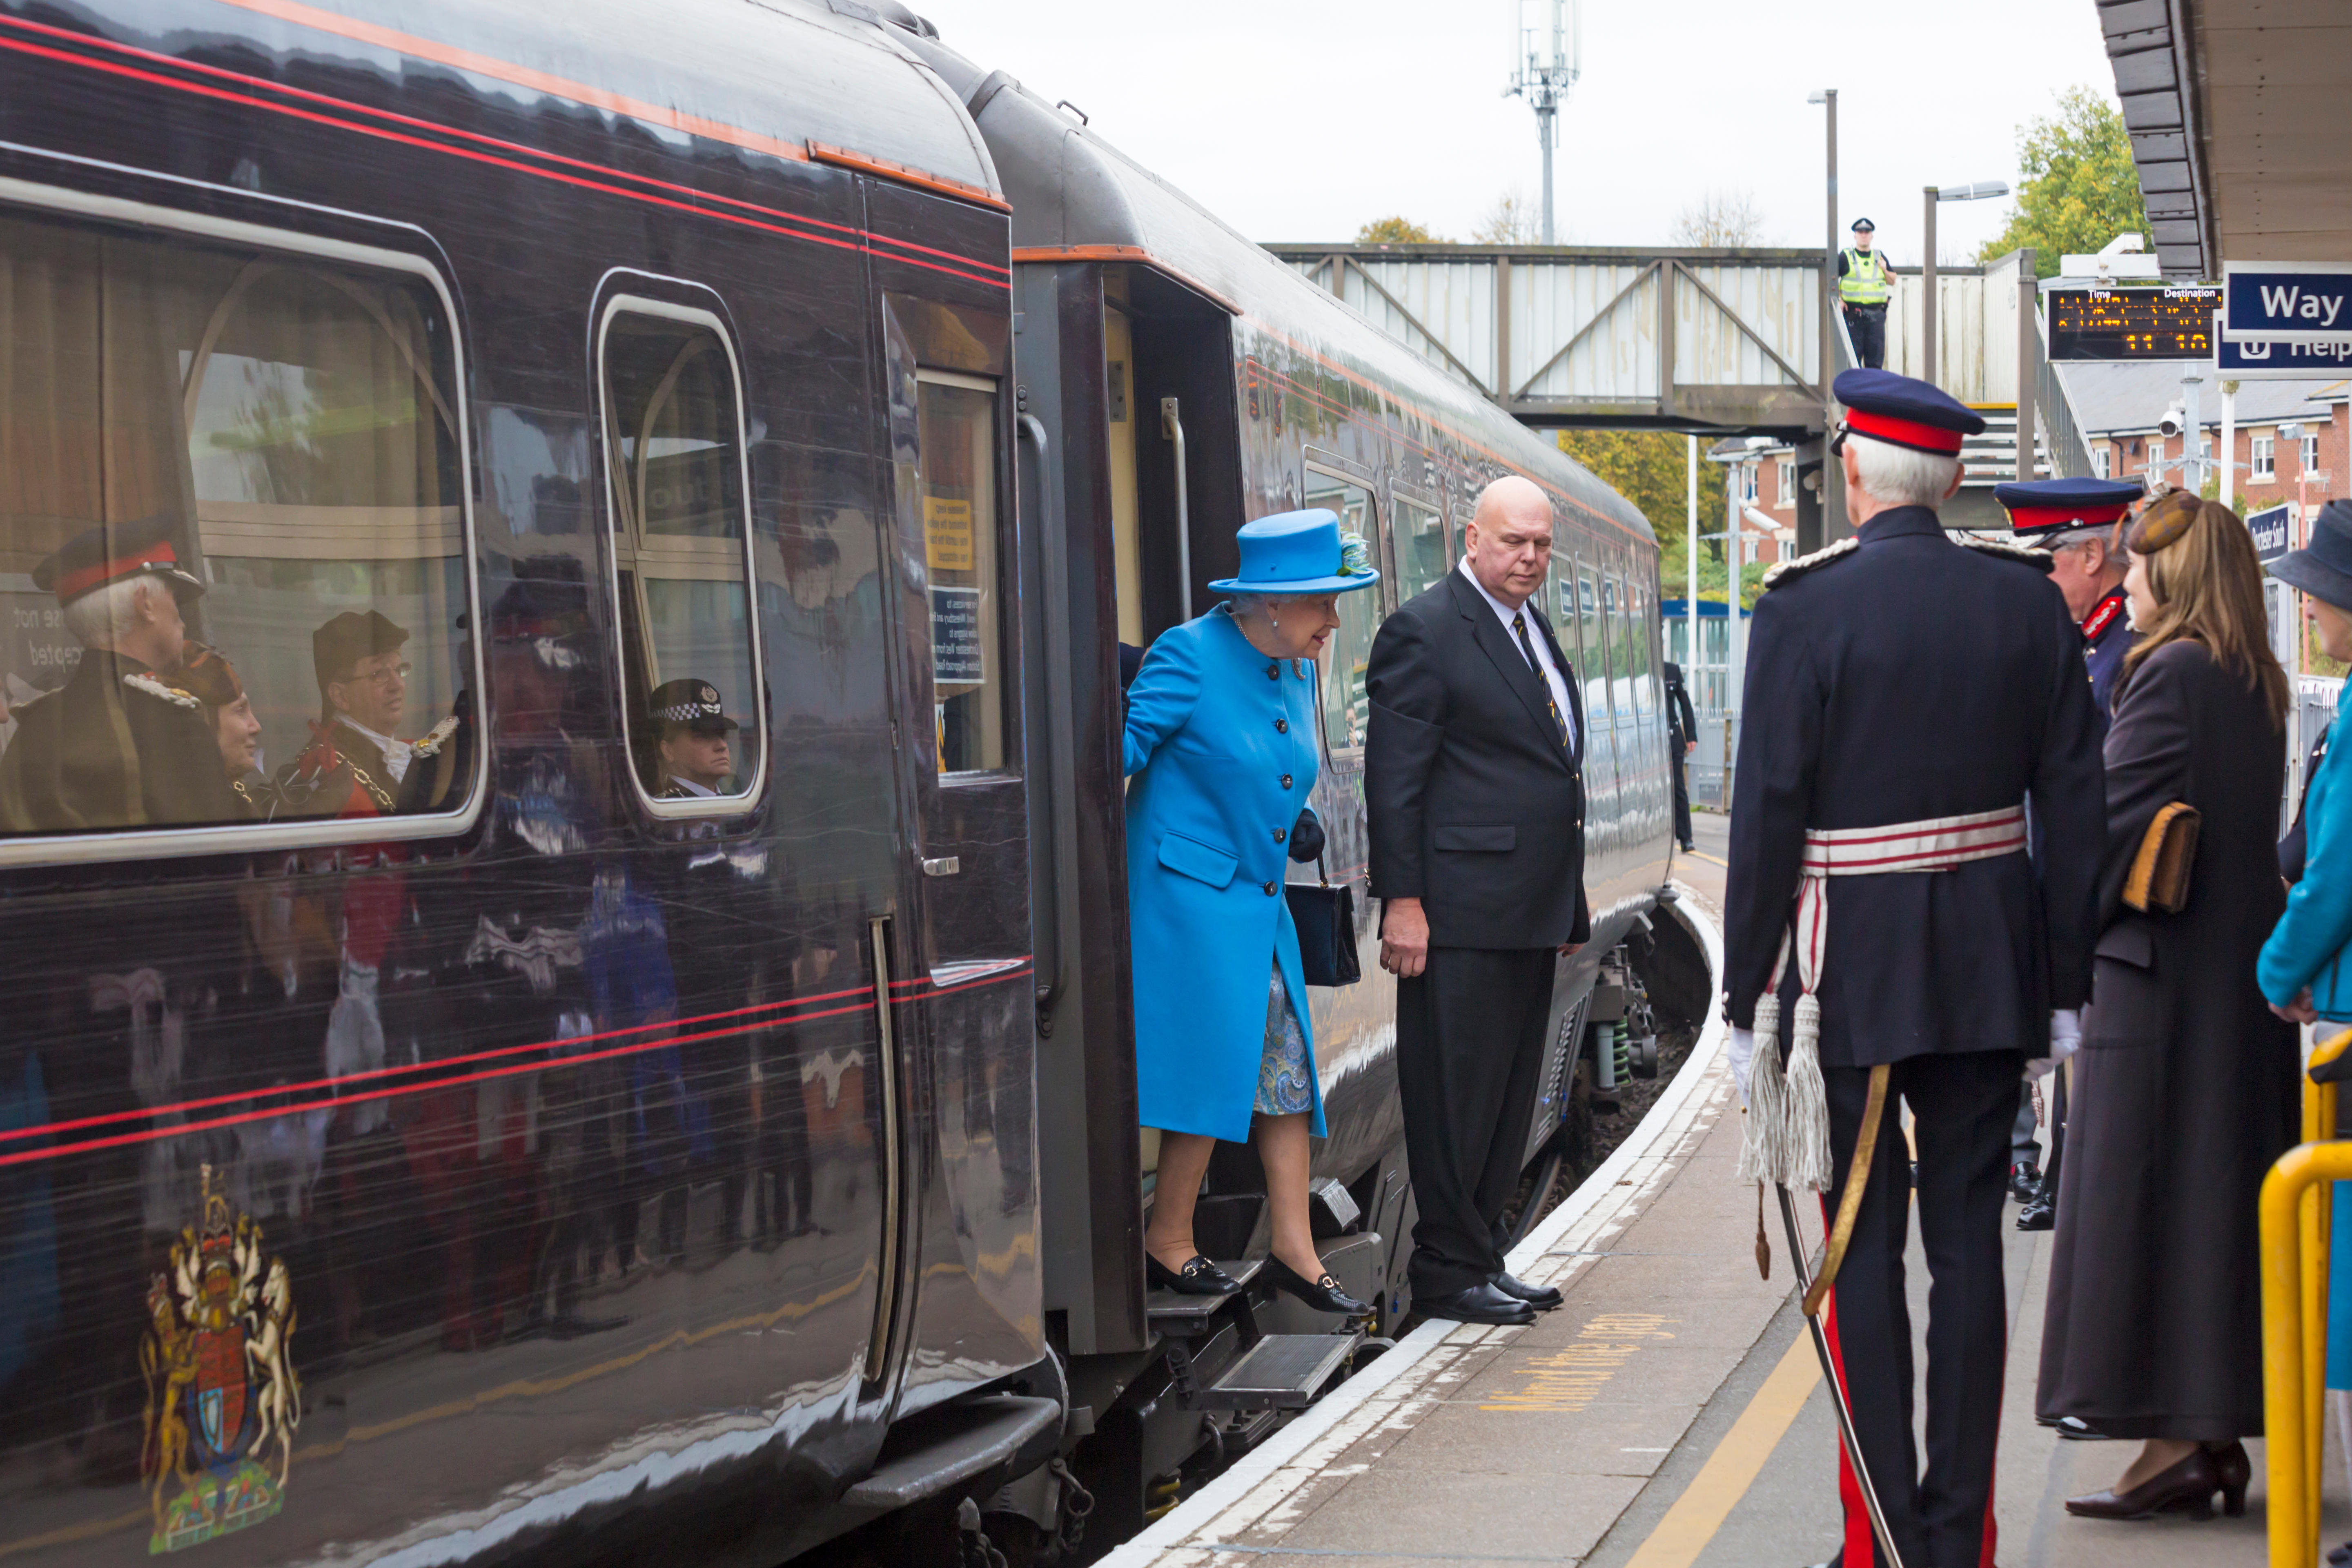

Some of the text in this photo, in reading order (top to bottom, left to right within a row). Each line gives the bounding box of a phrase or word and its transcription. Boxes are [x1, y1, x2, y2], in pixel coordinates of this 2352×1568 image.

[2088, 289, 2215, 299] Time Destination
[2260, 286, 2344, 327] Way
[2252, 519, 2285, 551] Dorchester South
[1577, 1313, 1683, 1340] gap
